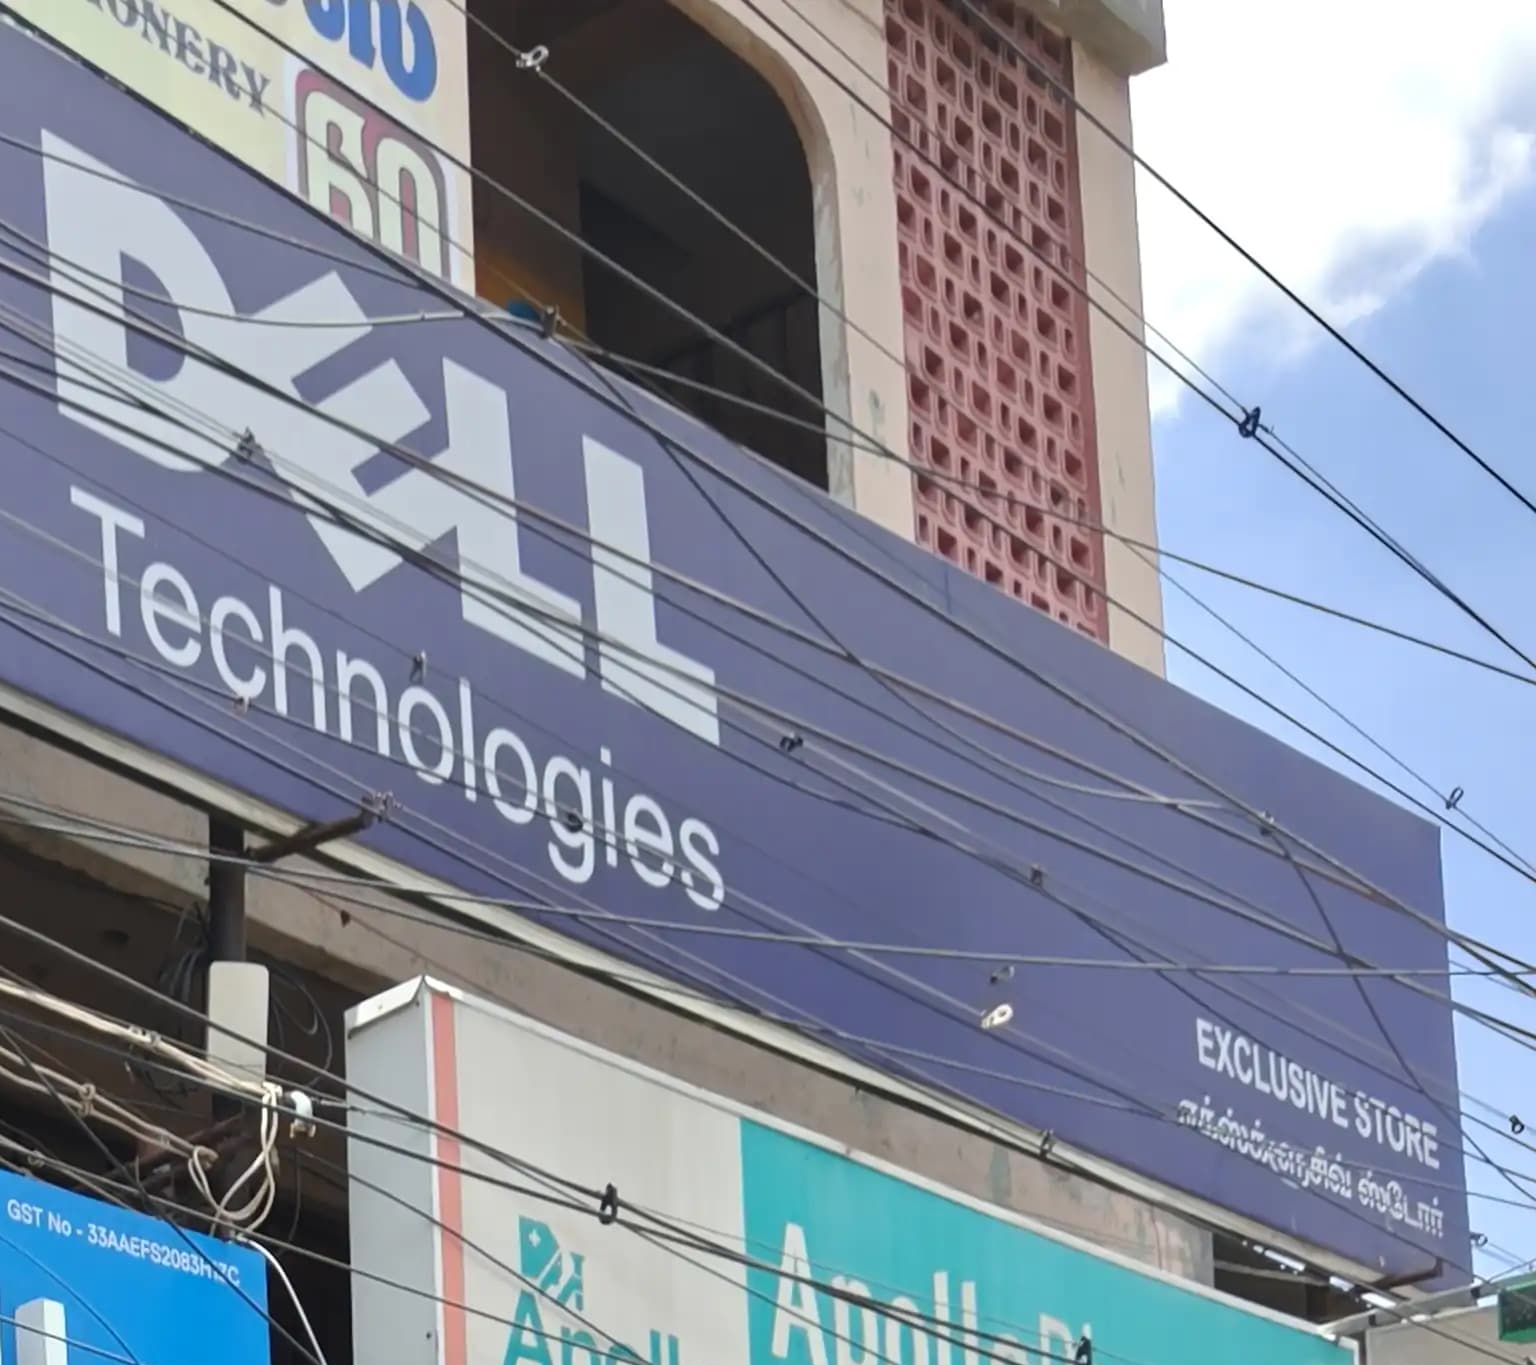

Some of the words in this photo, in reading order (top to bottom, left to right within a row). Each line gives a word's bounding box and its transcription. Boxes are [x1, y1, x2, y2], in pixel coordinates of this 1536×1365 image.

[41, 129, 719, 745] DELL
[71, 485, 724, 911] Technologies
[7, 1199, 43, 1227] GST
[48, 1211, 71, 1237] No
[1197, 1018, 1349, 1129] EXCLUSIVE
[1354, 1091, 1440, 1169] STORE
